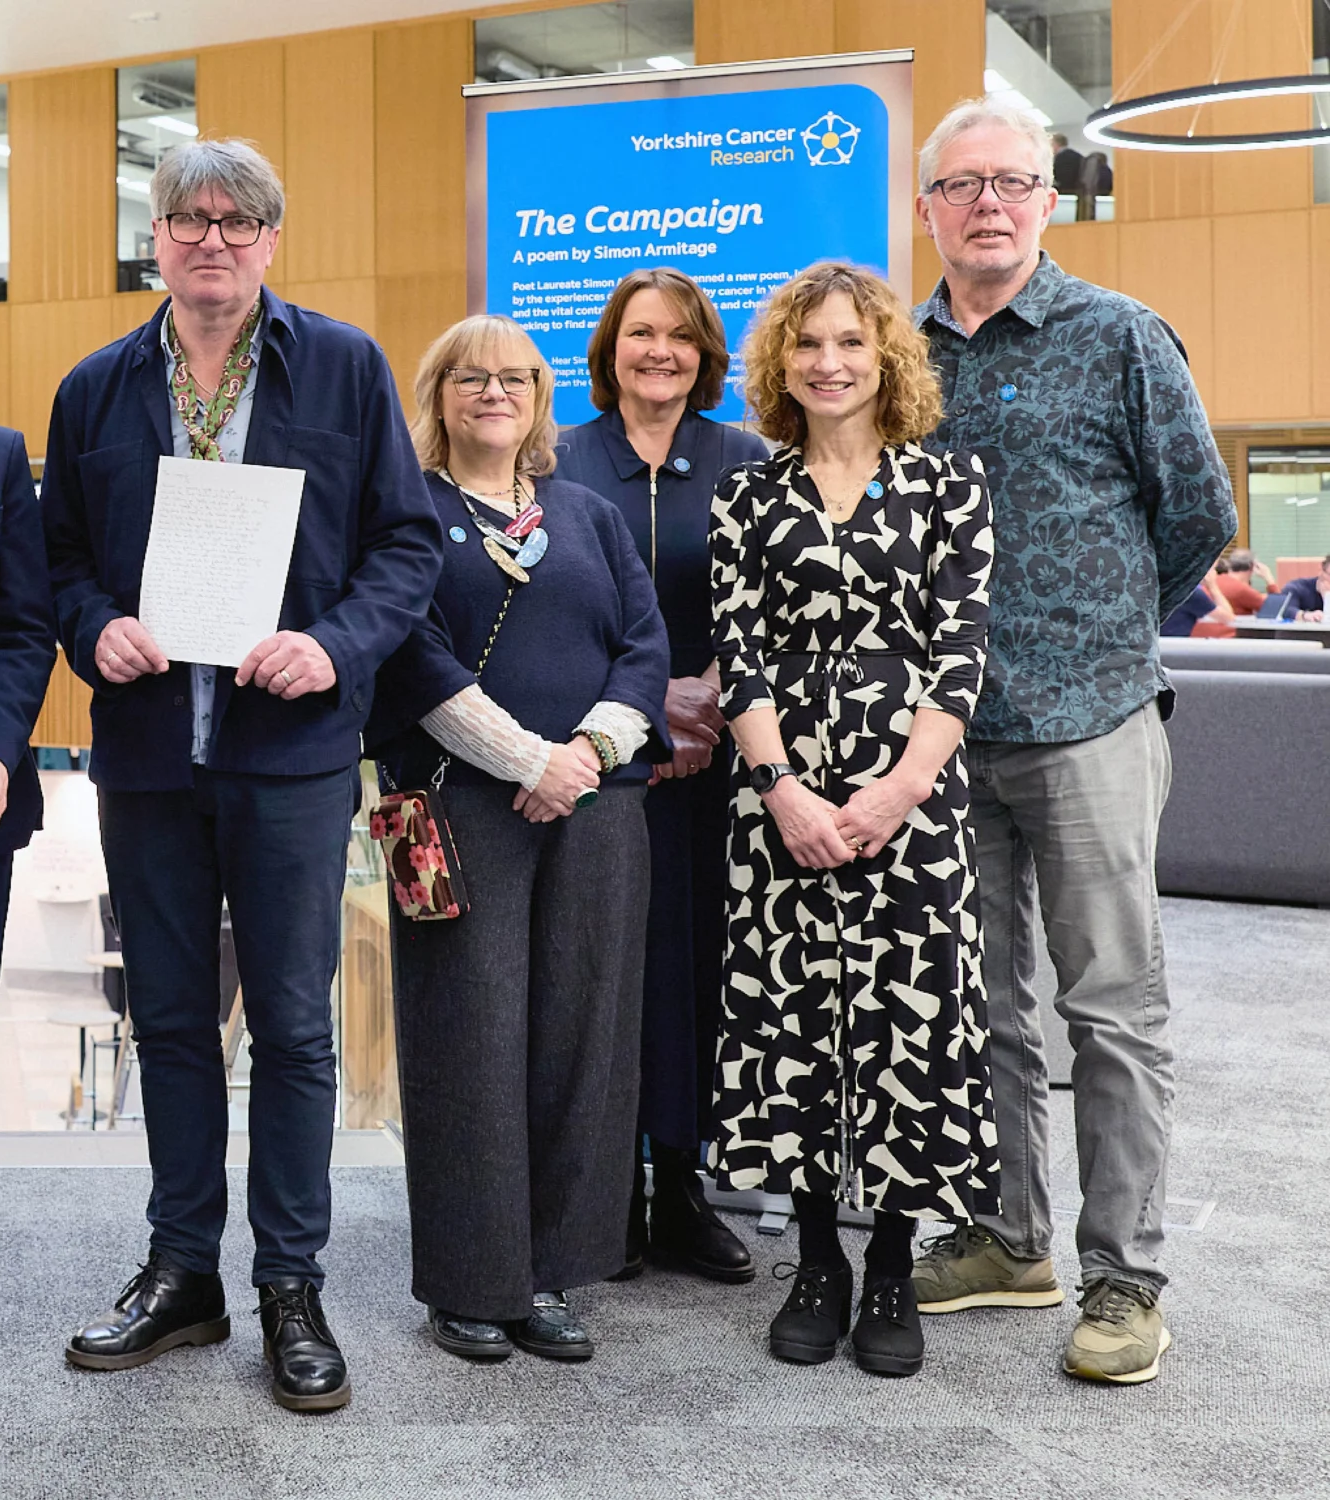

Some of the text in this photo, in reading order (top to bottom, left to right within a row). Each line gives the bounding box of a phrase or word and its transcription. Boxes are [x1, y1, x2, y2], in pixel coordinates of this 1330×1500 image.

[630, 127, 797, 152] Yorkshire Cancer
[710, 145, 795, 167] Research
[515, 198, 764, 238] The Campaign
[512, 240, 718, 265] A poem by Simon Armitage
[726, 274, 734, 282] a
[735, 273, 758, 281] new
[759, 271, 793, 282] poem,
[512, 281, 536, 291] Poet
[536, 280, 582, 290] Laureate
[582, 277, 616, 289] Simon
[717, 286, 755, 296] cancer
[755, 285, 767, 294] in
[512, 296, 526, 306] by
[526, 294, 544, 304] the
[544, 292, 606, 305] experiences
[719, 300, 741, 310] and
[512, 308, 531, 318] and
[532, 307, 550, 317] the
[550, 306, 574, 316] vital
[551, 321, 563, 330] to
[564, 320, 585, 329] find
[552, 356, 572, 365] Hear
[577, 368, 585, 376] it
[572, 378, 588, 387] the
